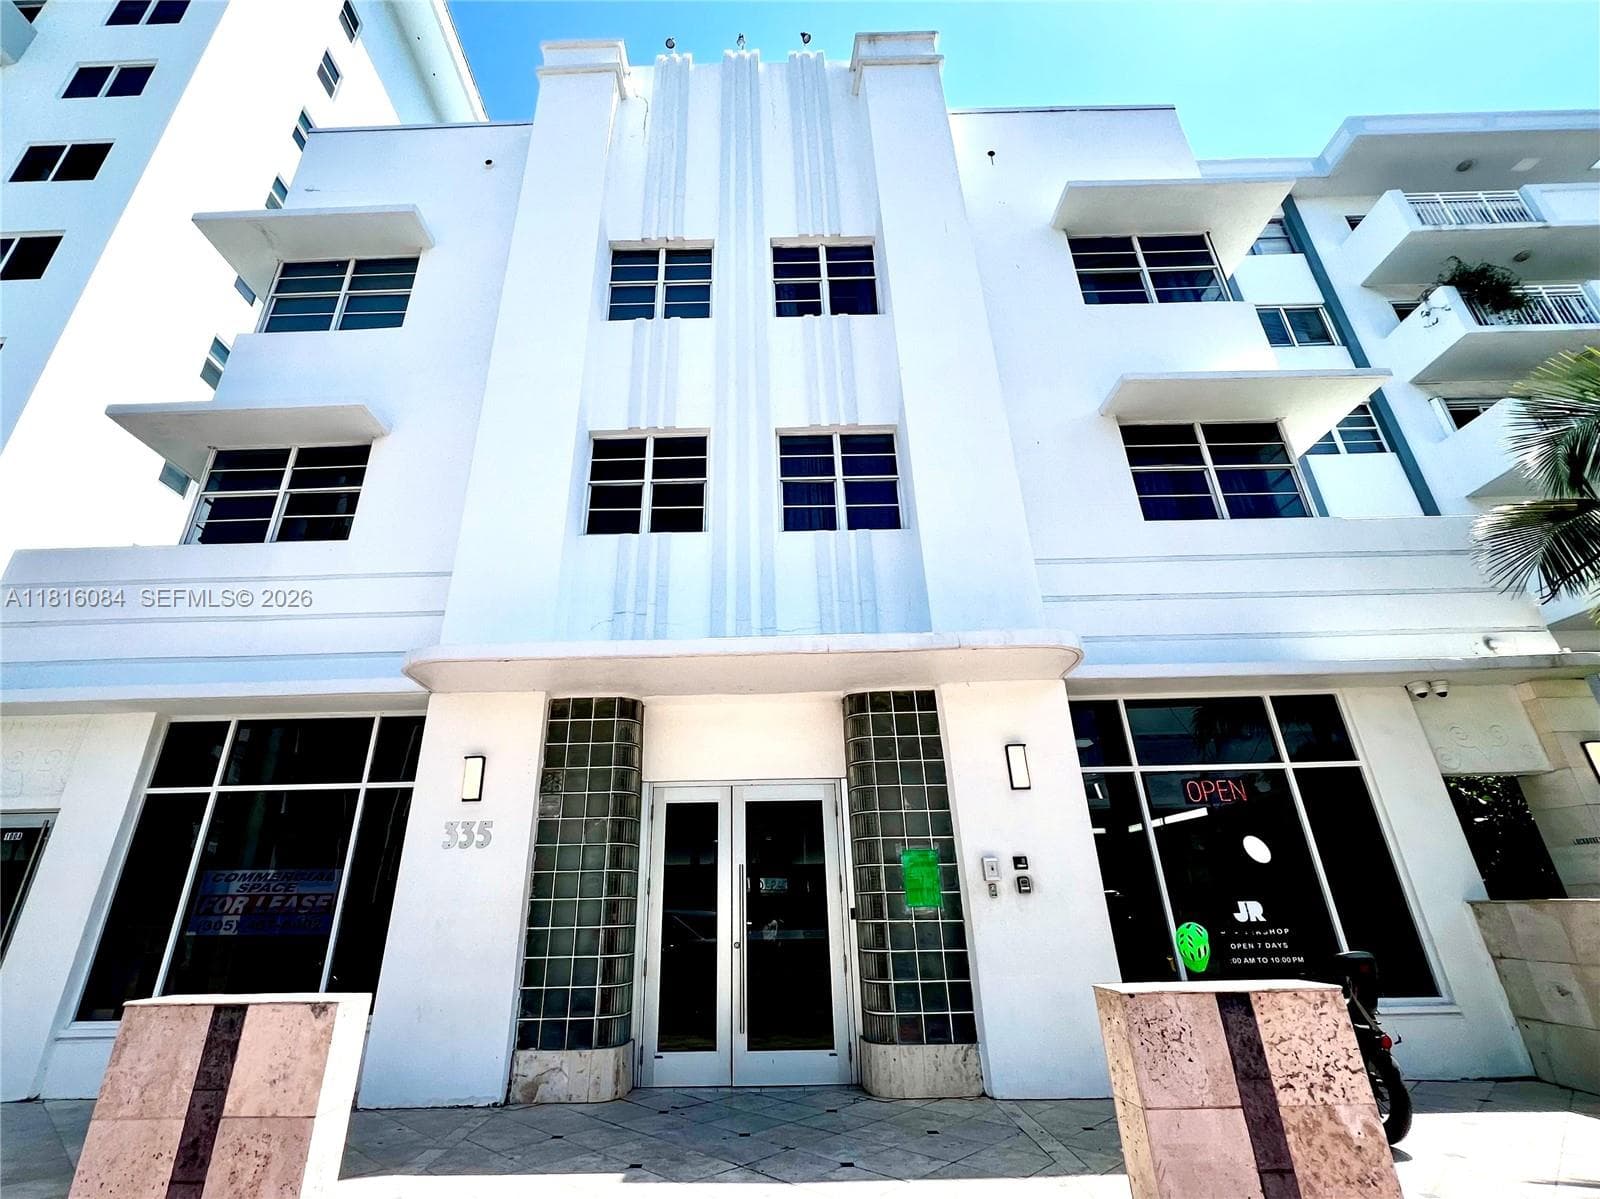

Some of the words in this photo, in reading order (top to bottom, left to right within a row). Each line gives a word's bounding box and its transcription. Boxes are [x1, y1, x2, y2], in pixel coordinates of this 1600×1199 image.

[1186, 779, 1248, 804] OPEN
[441, 820, 494, 850] 335
[212, 870, 336, 883] COMMERCIAL
[236, 882, 297, 893] SPACE
[197, 894, 251, 915] FOR
[254, 894, 334, 914] LEASE
[1232, 900, 1267, 923] JR
[1230, 942, 1255, 950] OPEN
[1292, 956, 1305, 964] PM
